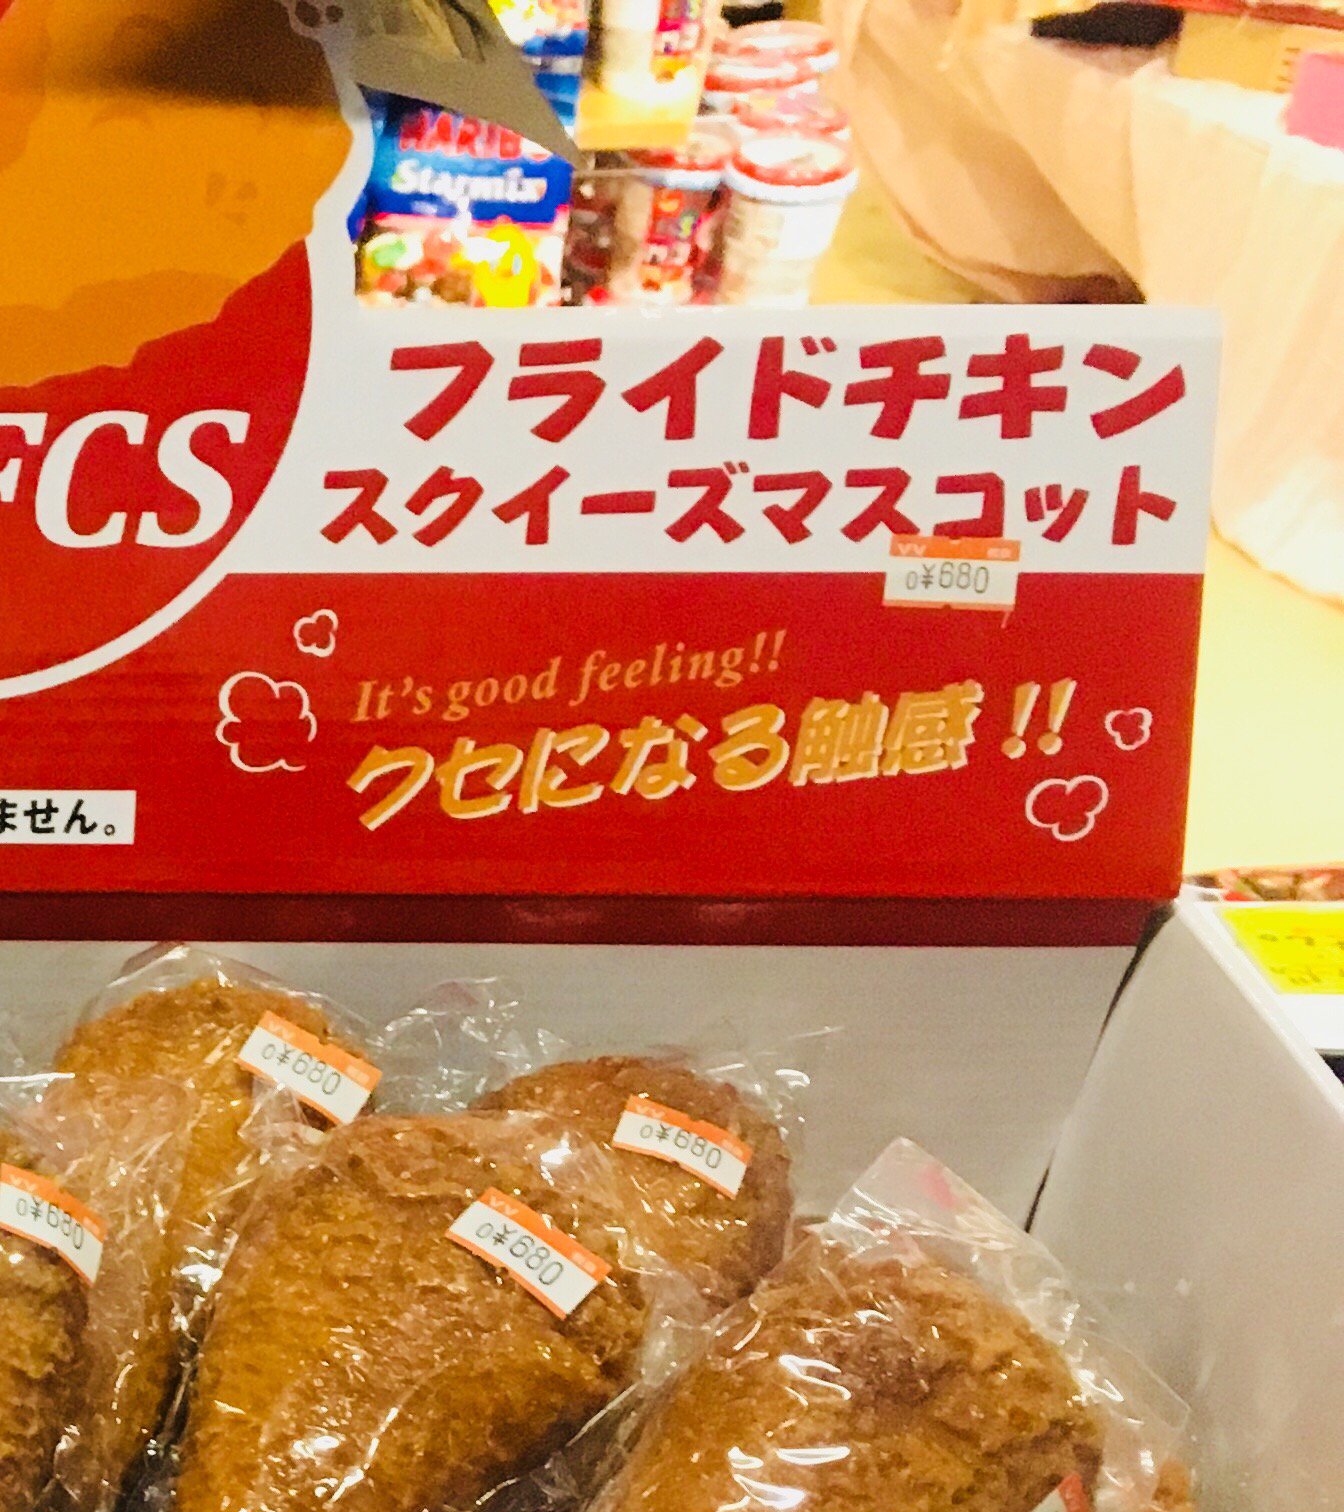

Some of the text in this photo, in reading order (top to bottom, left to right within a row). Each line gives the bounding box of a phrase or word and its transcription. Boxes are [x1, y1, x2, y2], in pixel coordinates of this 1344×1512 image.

[398, 109, 552, 163] HARIB
[390, 333, 1186, 443] フライドチキン
[320, 459, 1177, 548] スクイーズマスコット
[350, 629, 789, 726] It's good feeling!!
